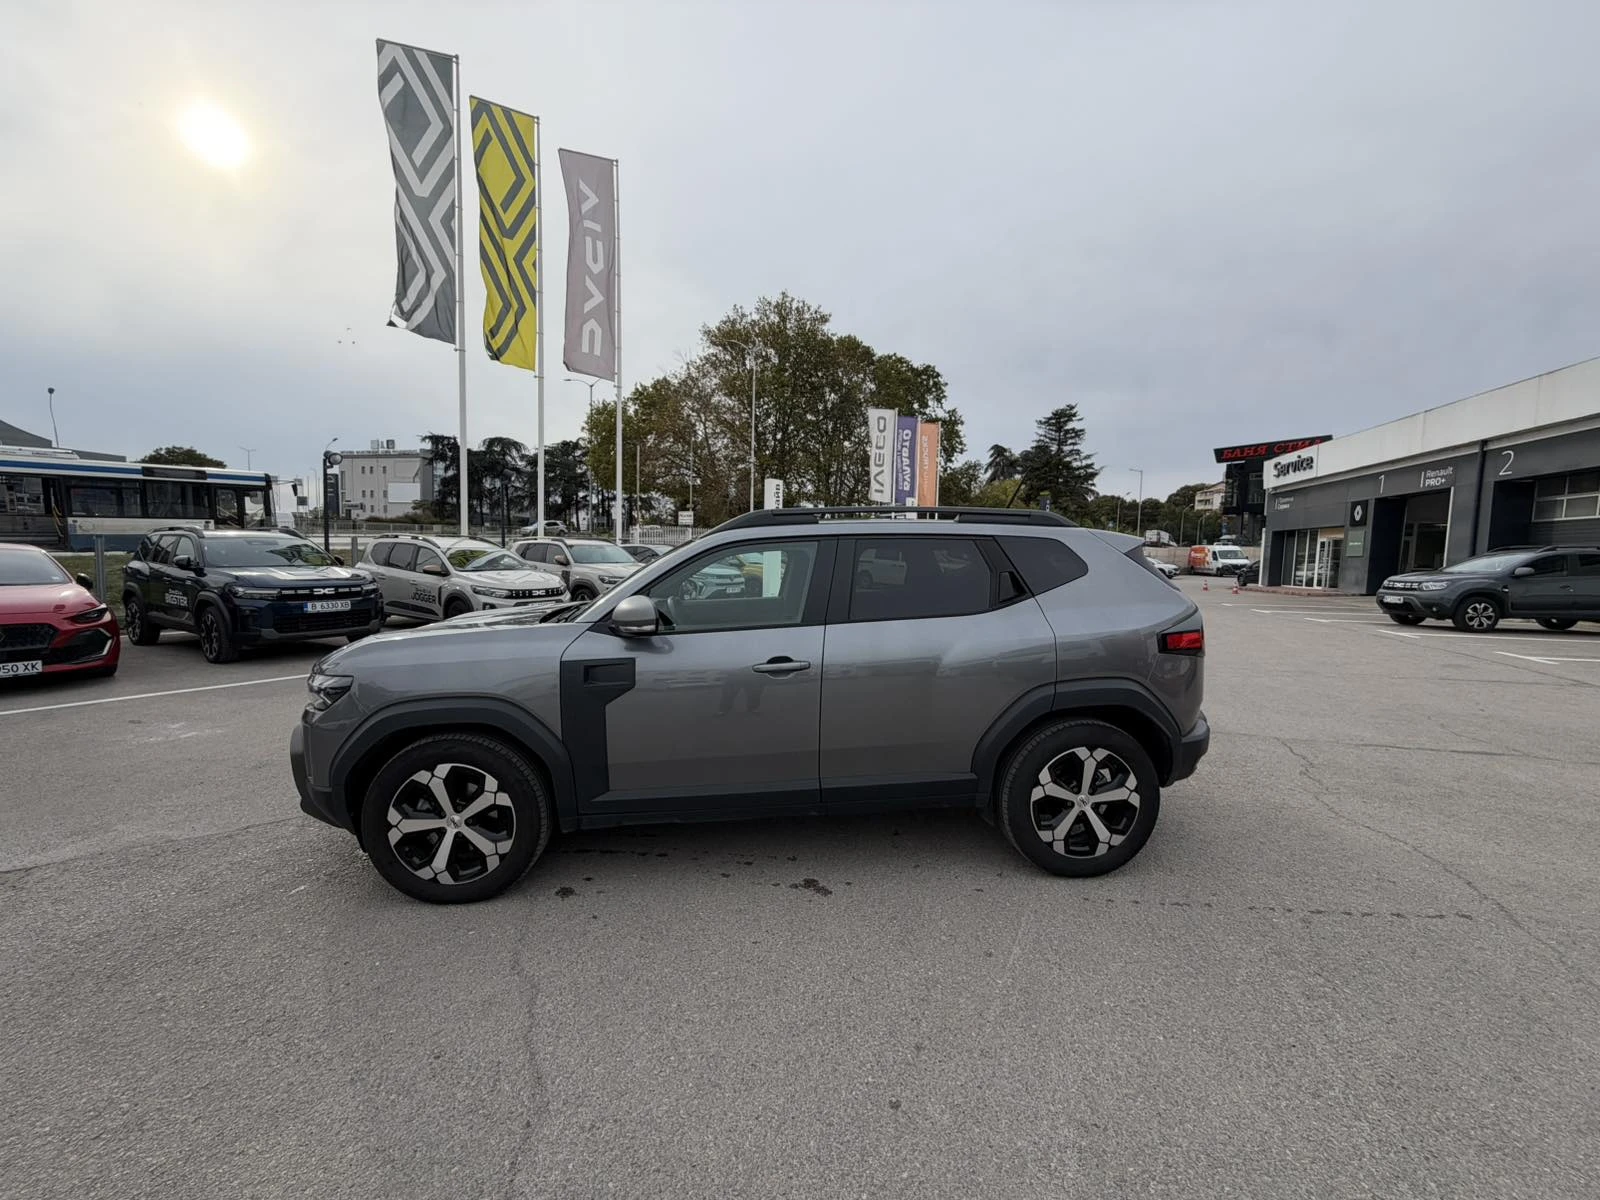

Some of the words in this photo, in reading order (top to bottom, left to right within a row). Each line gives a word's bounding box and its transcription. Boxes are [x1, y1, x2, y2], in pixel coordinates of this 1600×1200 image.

[1221, 445, 1267, 459] БАНЯ
[1273, 455, 1314, 478] Service
[1499, 450, 1514, 475] 2
[1425, 466, 1453, 477] Renault
[1379, 474, 1385, 494] 1
[1425, 478, 1446, 487] PRO+
[411, 591, 436, 604] JOGGER
[0, 663, 19, 674] 50
[22, 662, 39, 672] XK
